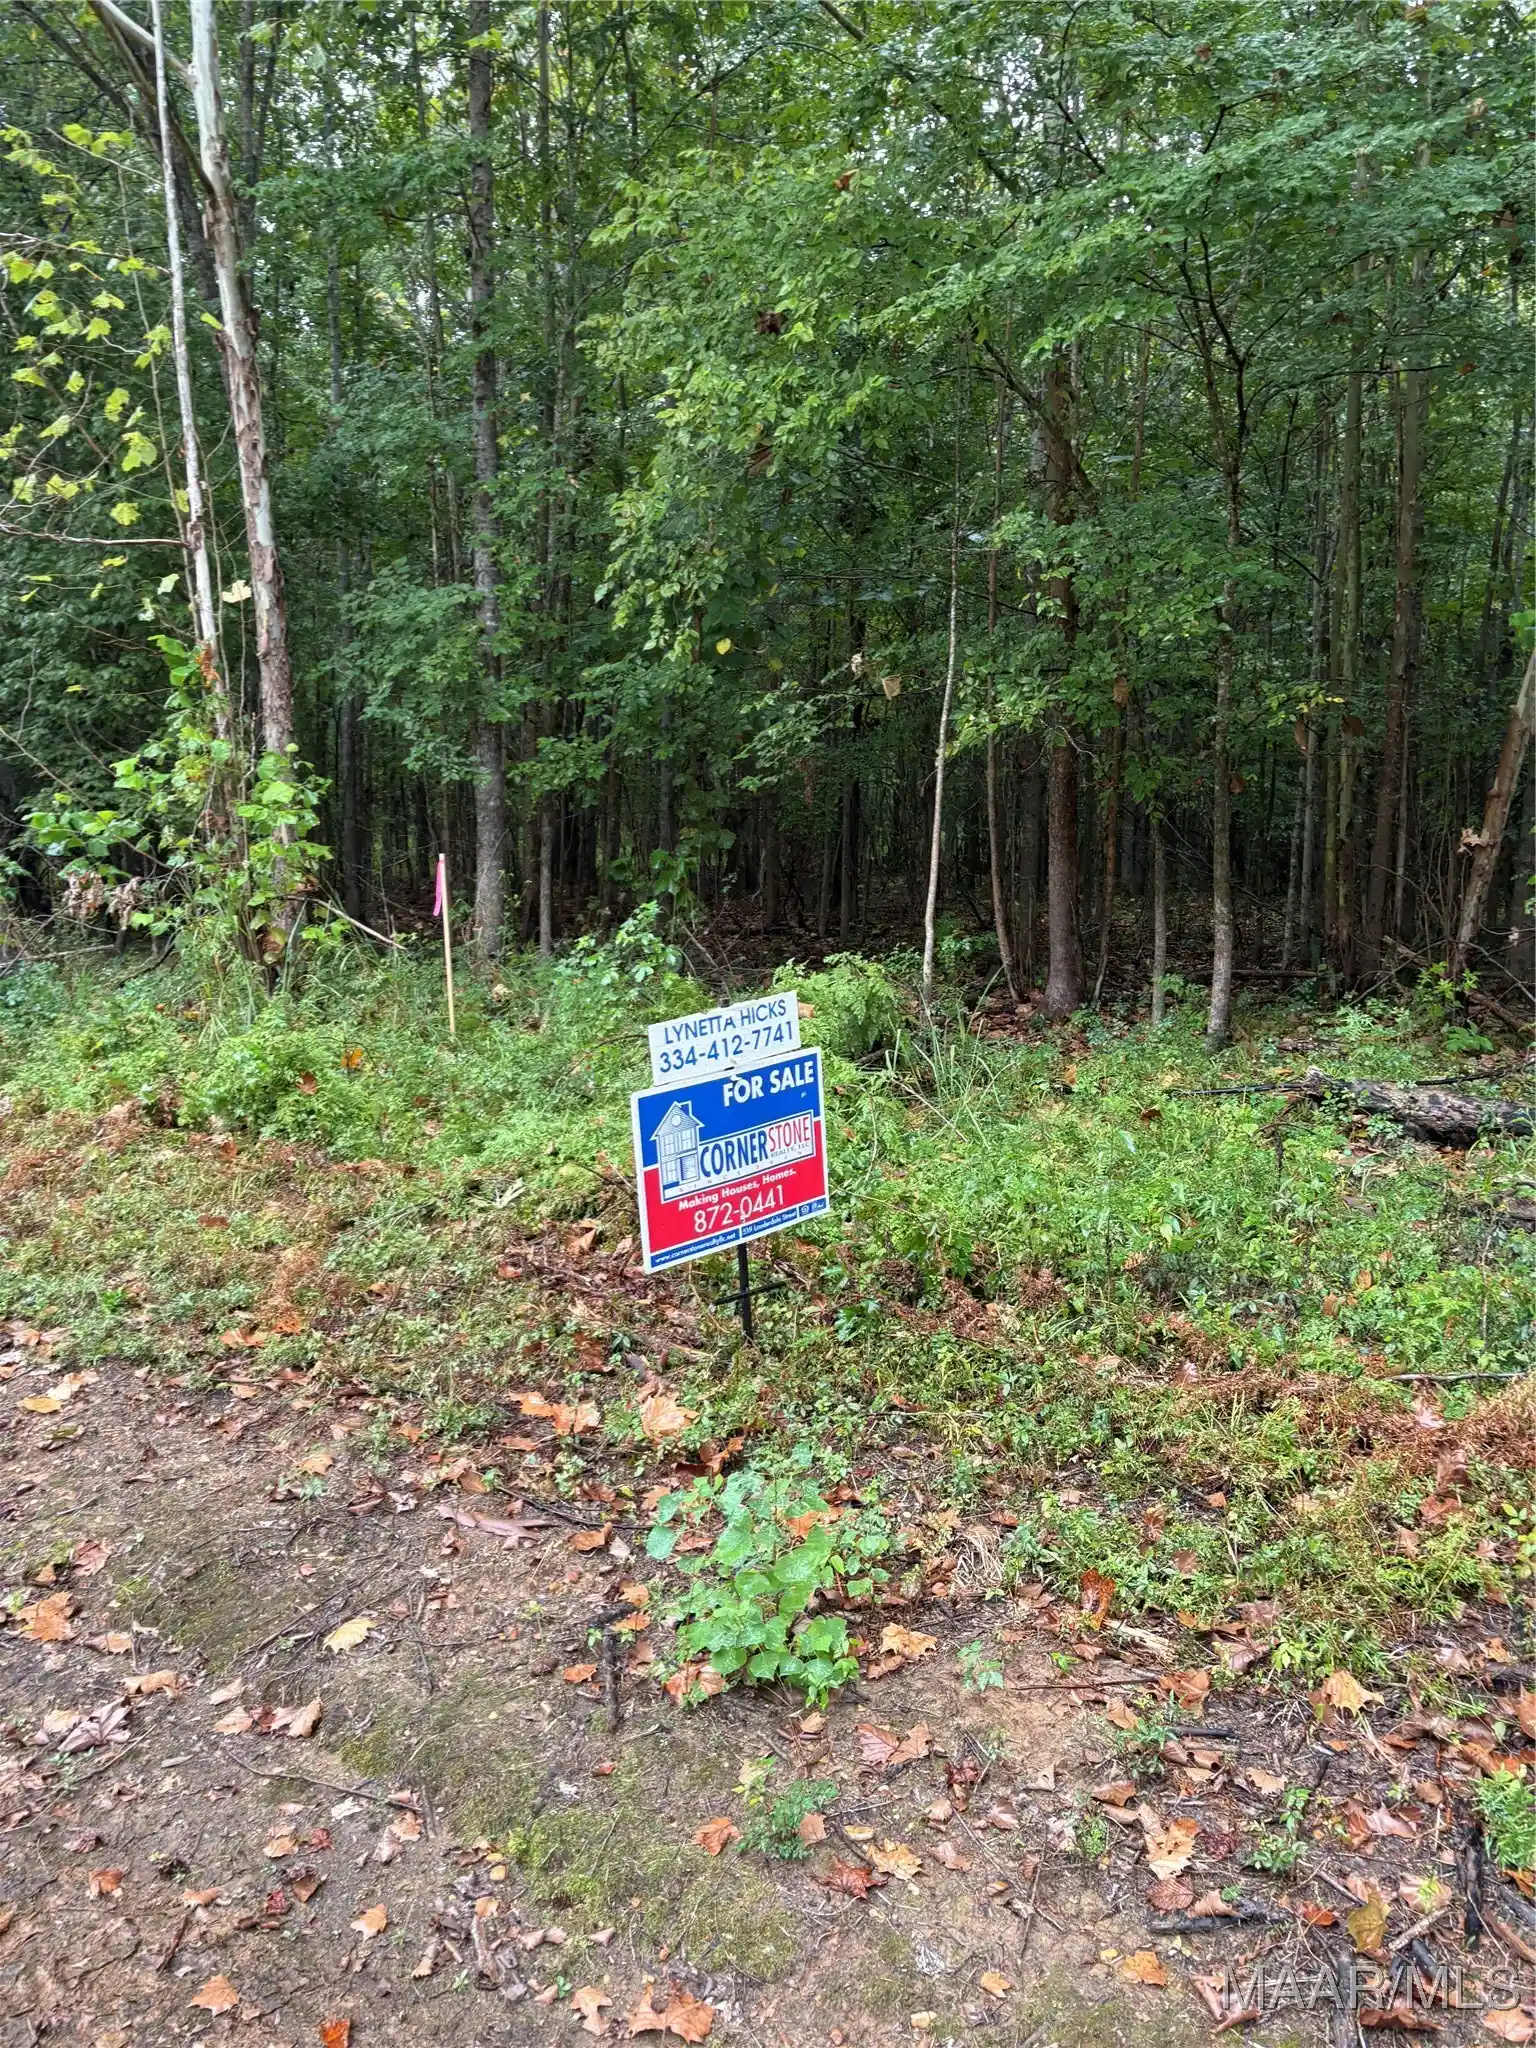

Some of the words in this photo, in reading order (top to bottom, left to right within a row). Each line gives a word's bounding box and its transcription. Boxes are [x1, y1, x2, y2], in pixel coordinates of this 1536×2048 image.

[664, 1014, 736, 1045] LYNETTA
[740, 1000, 787, 1024] HICKS
[660, 1021, 793, 1073] 334-412-7741
[723, 1076, 765, 1107] FOR
[770, 1061, 815, 1092] SALE
[699, 1115, 811, 1178] CORNERSTONE
[678, 1191, 719, 1211] Making
[721, 1179, 760, 1198] Houses,
[762, 1168, 797, 1185] Homes.
[693, 1184, 785, 1233] 872-0441
